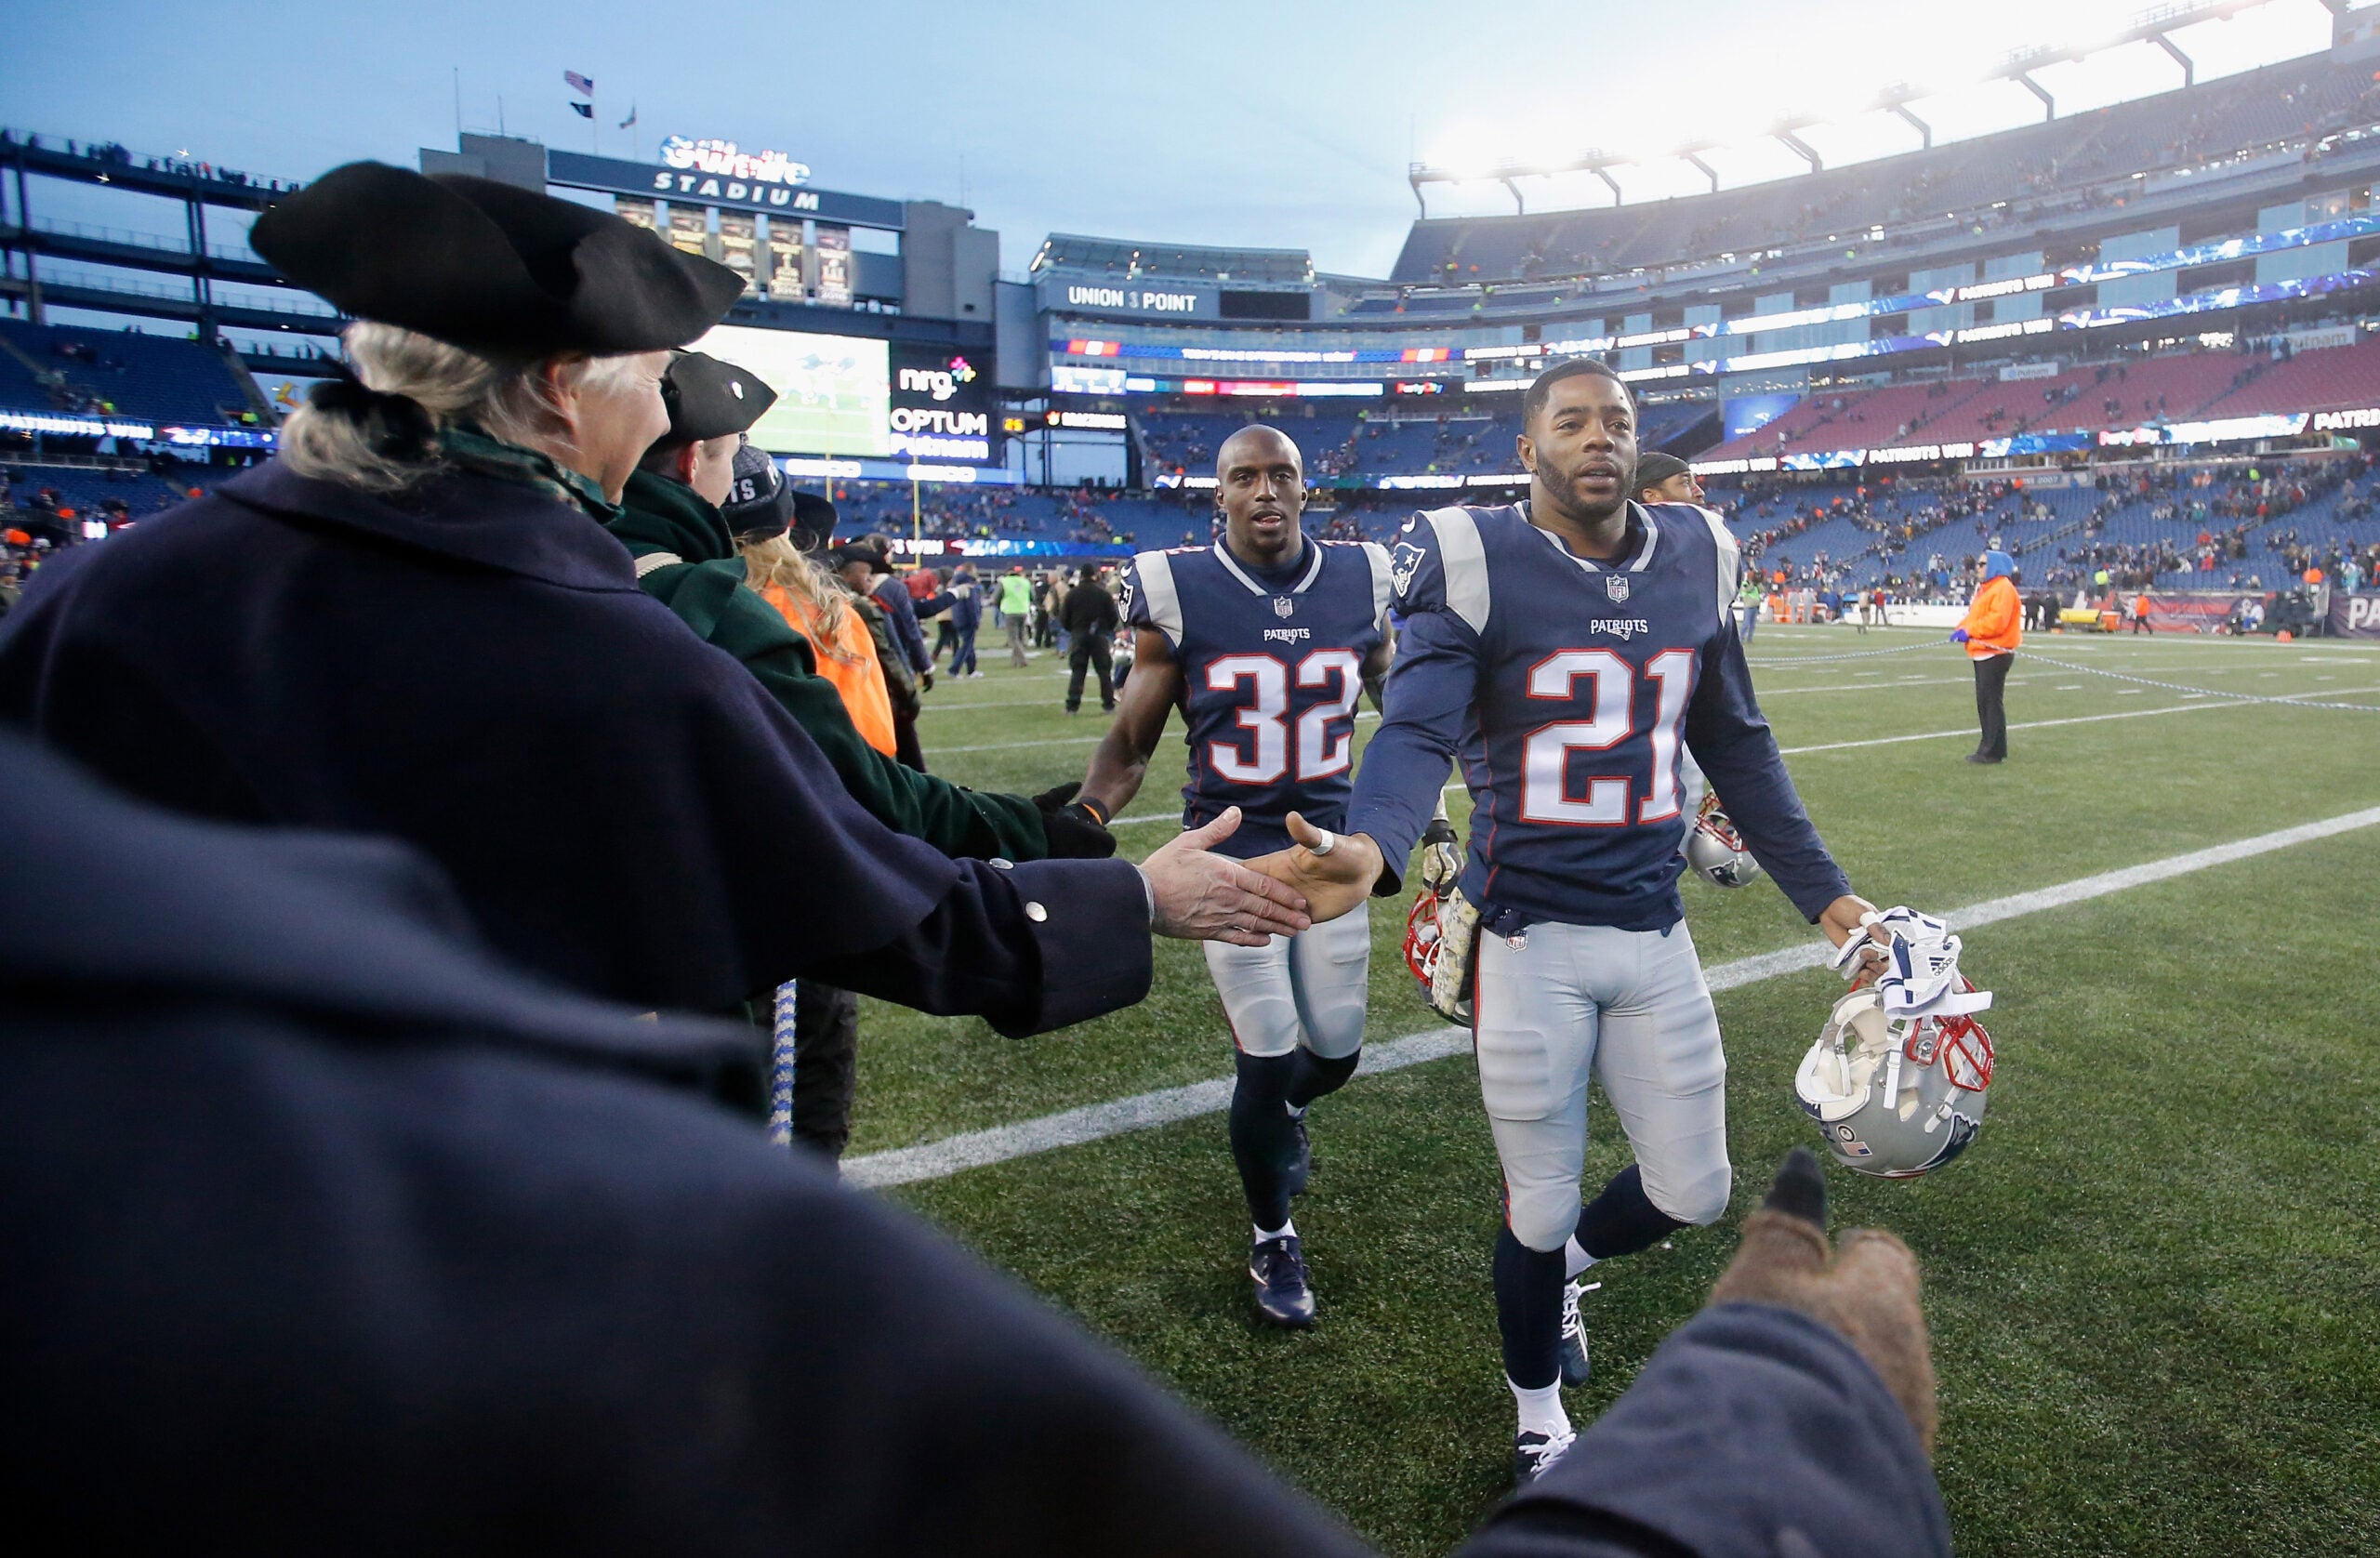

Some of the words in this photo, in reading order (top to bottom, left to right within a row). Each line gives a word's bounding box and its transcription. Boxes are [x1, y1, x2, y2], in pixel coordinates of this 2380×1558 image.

[654, 171, 820, 211] STADIUM
[1068, 285, 1124, 308] UNION
[1142, 292, 1197, 312] POINT
[890, 407, 988, 436] OPTUM
[2314, 408, 2380, 431] PATRI
[889, 432, 989, 459] Putnam
[1869, 445, 1941, 464] PATRIOTS
[1941, 442, 1974, 459] WIN
[1263, 627, 1311, 641] PATRIOTS
[1590, 619, 1648, 635] PATRIOTS
[1205, 648, 1362, 786] 32
[1519, 647, 1695, 825] 21
[1934, 957, 1955, 977] adidas
